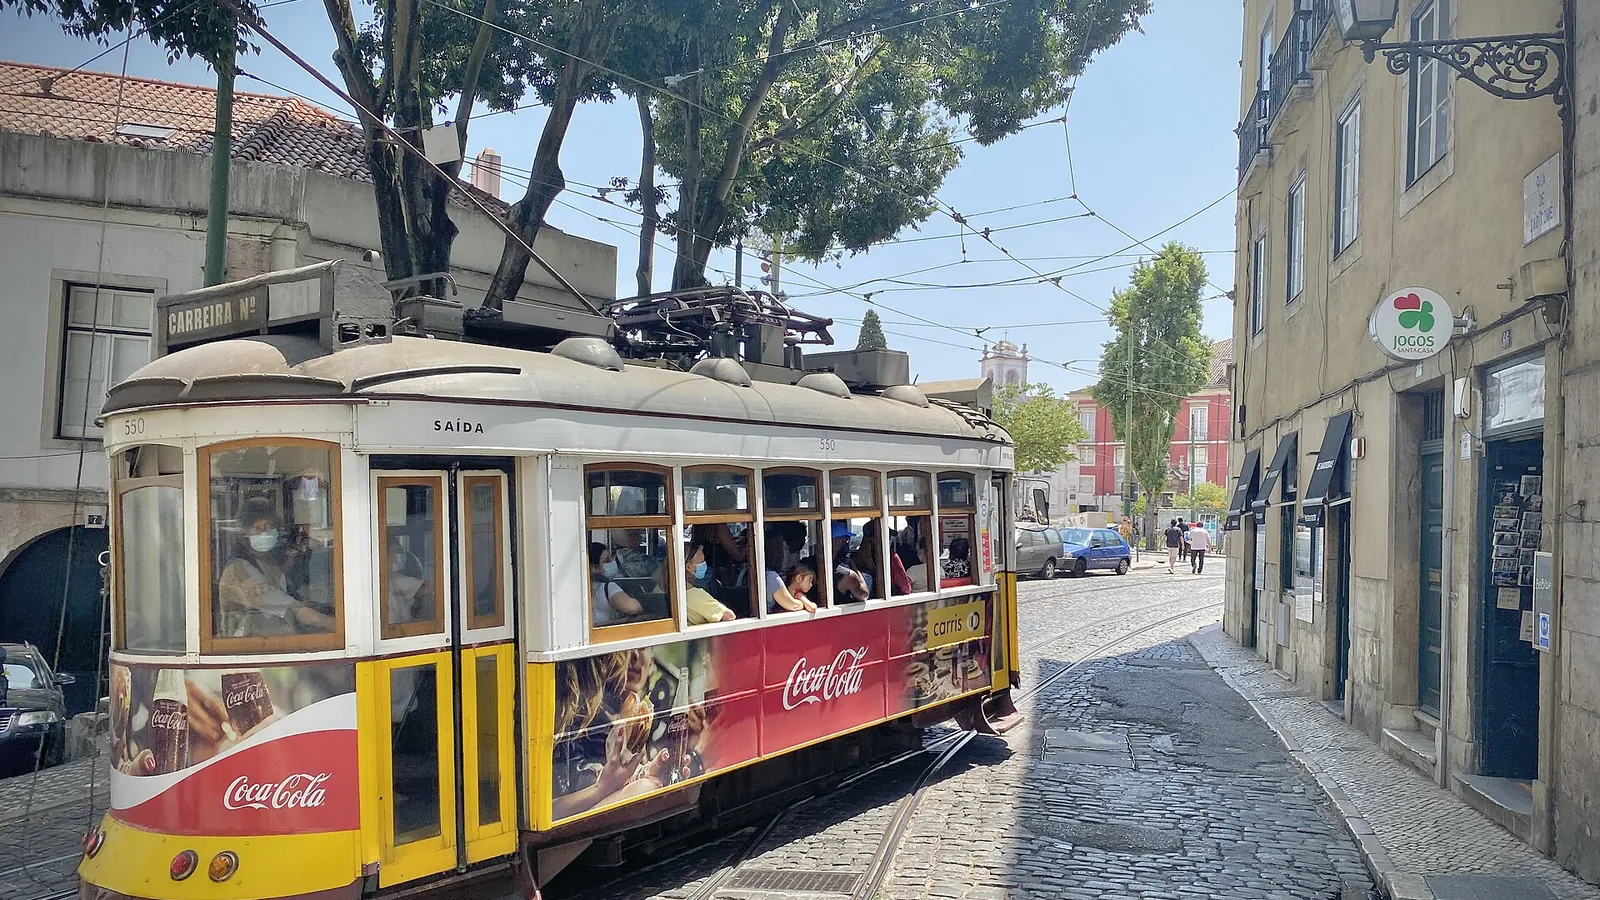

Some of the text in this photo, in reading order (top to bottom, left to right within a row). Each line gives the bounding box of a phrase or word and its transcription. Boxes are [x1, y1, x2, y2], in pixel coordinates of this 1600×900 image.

[168, 301, 233, 335] CARREIRA
[1393, 335, 1434, 349] JOGOS
[125, 417, 145, 436] 550
[434, 417, 484, 434] SAÍDA
[819, 438, 835, 451] 550
[92, 515, 98, 524] 7
[933, 613, 963, 637] carris
[782, 645, 869, 711] Coca-Cola
[223, 772, 332, 810] Coca-Cola
